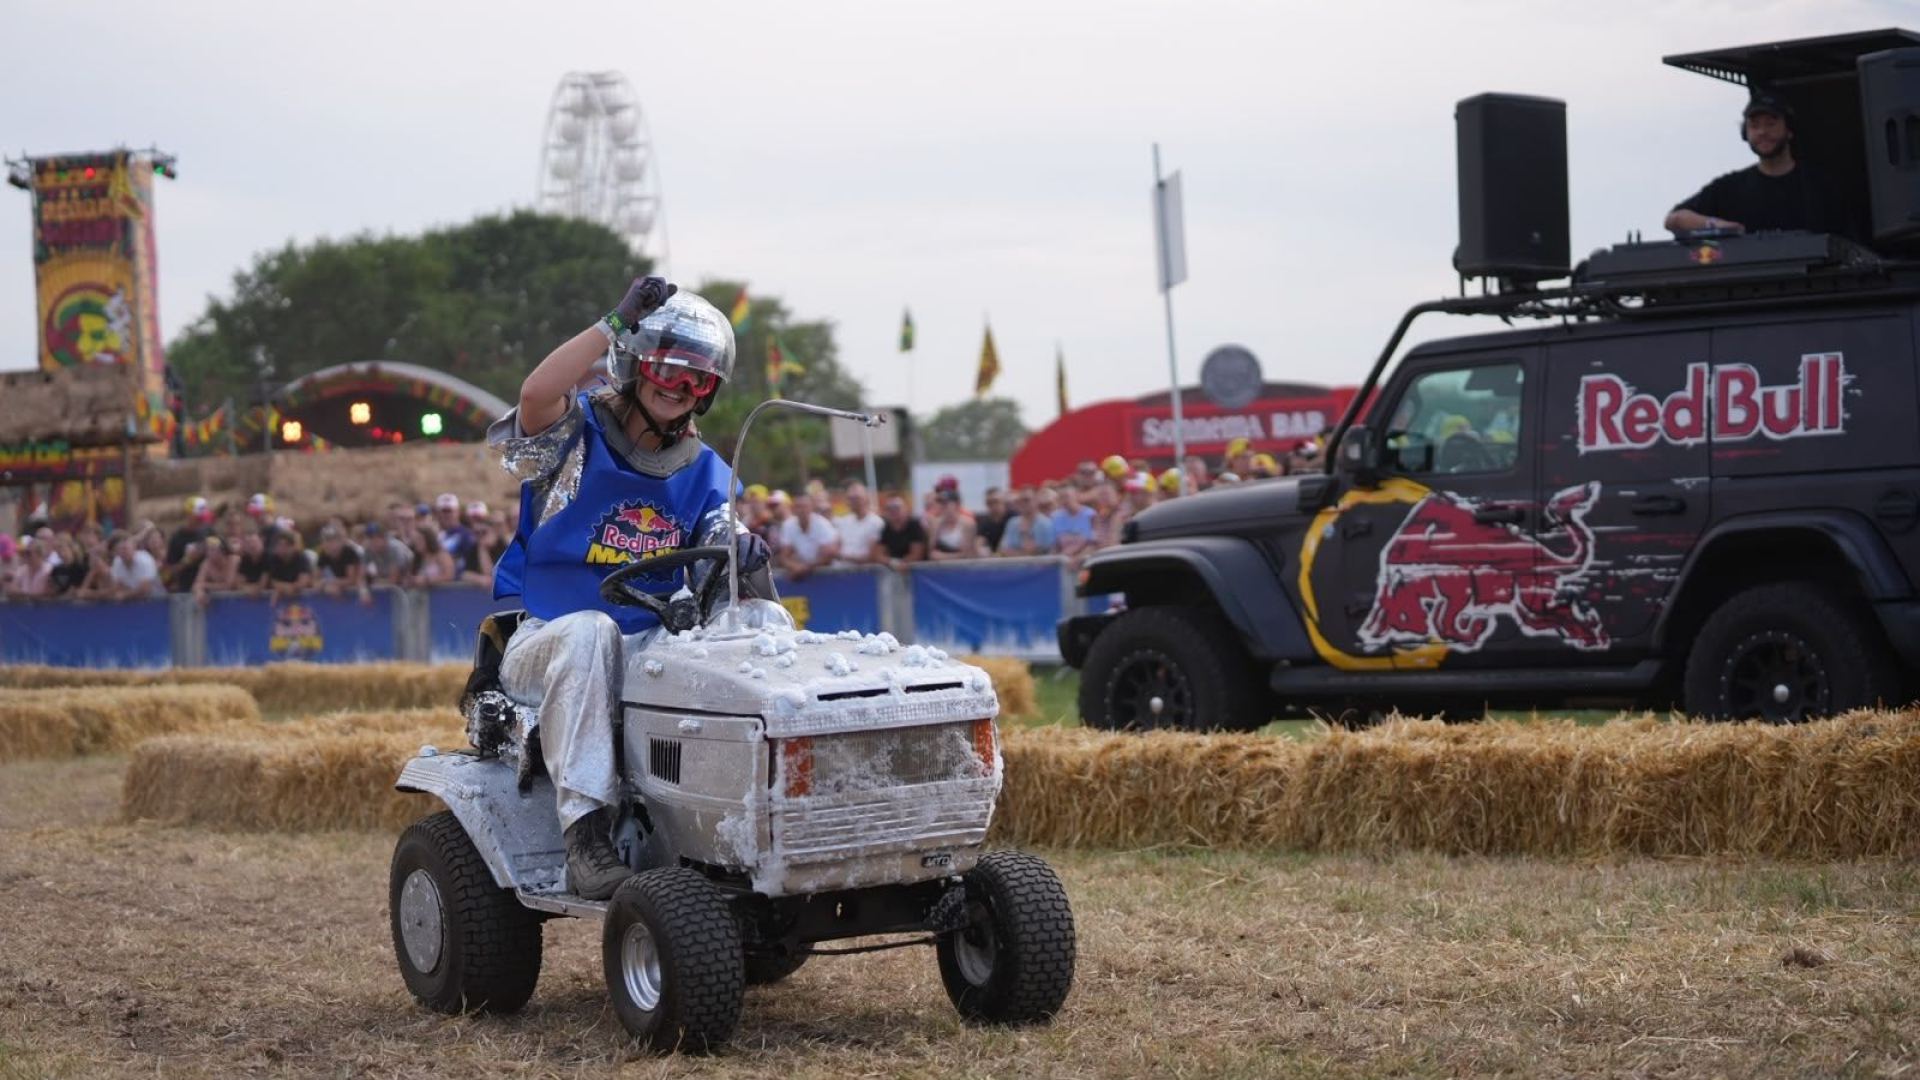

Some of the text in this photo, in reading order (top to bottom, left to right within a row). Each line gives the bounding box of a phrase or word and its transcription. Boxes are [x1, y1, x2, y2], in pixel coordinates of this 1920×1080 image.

[1579, 352, 1844, 452] Red Bull
[1271, 411, 1325, 438] BAR
[602, 524, 681, 553] Red Bull
